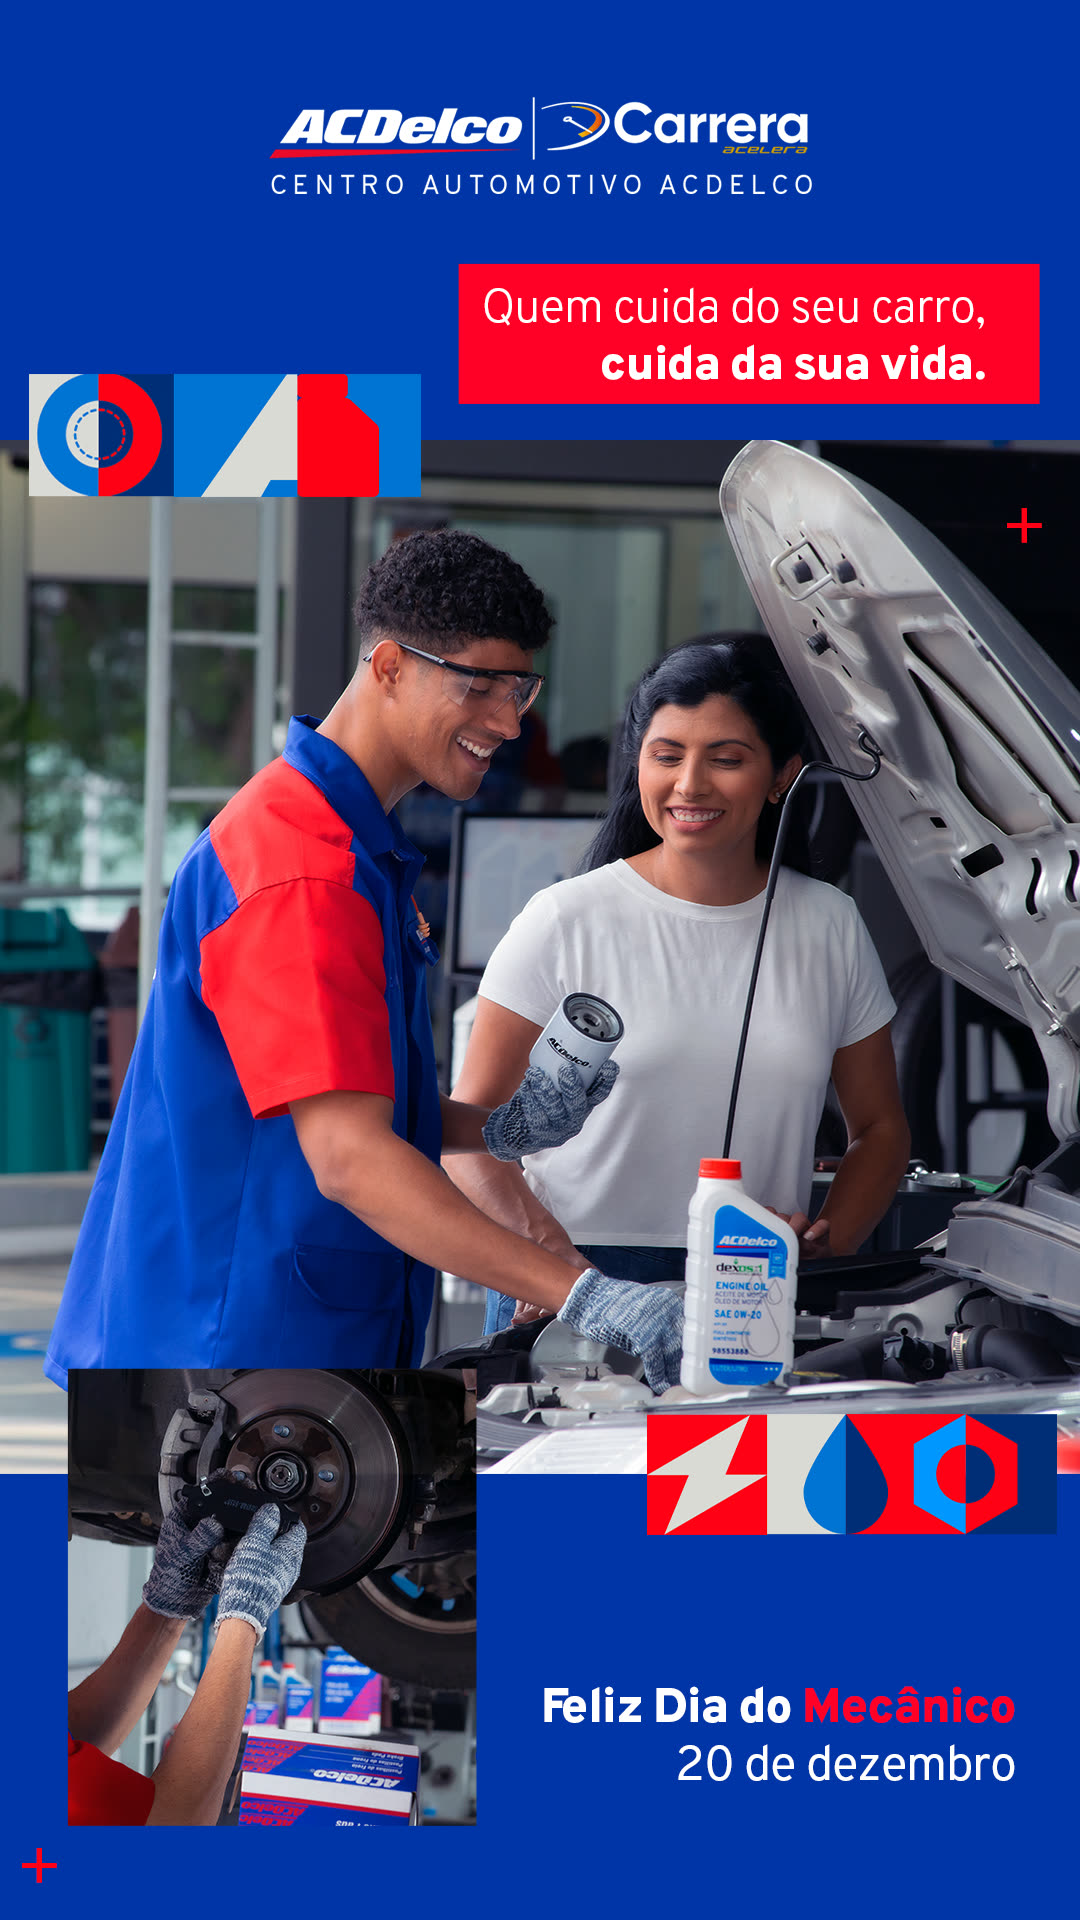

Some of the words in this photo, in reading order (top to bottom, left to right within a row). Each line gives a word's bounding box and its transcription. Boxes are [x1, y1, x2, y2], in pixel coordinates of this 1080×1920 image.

[548, 1037, 590, 1067] ACDelco
[719, 1235, 778, 1247] ACDelco
[716, 1281, 751, 1291] ENGINE
[753, 1282, 769, 1291] OIL
[714, 1309, 732, 1319] SAE
[734, 1309, 762, 1319] 0W-20
[313, 1769, 400, 1788] ACDelco
[241, 1801, 306, 1816] ACDelco
